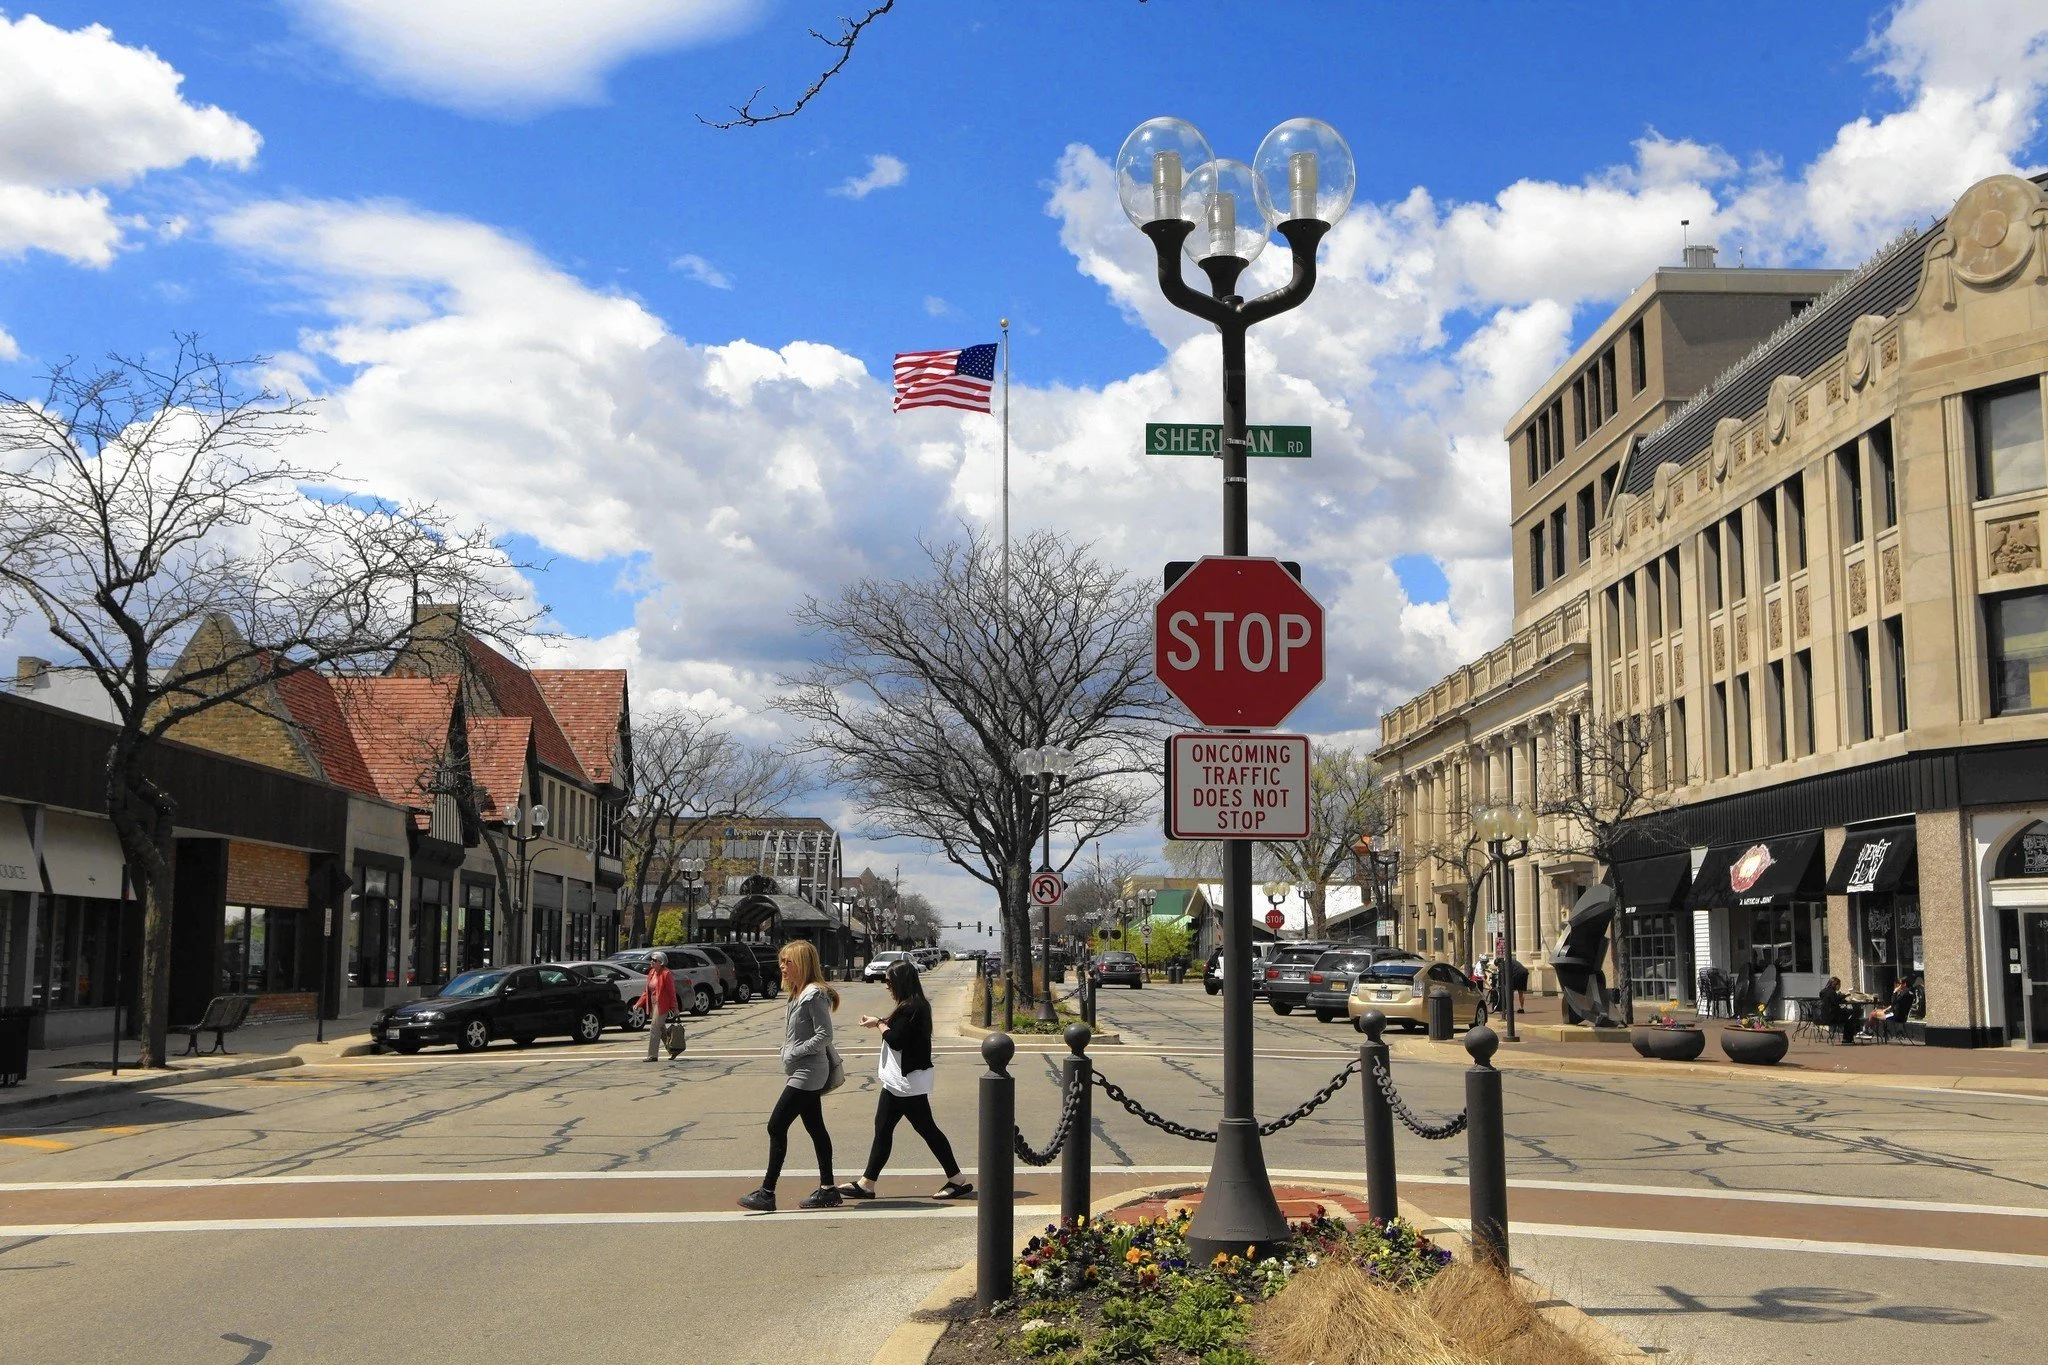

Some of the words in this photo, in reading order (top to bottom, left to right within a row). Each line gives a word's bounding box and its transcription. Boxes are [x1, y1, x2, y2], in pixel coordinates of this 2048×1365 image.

[1154, 428, 1274, 453] SHERIAN
[1287, 441, 1304, 453] RD
[1166, 610, 1313, 673] STOP
[1192, 744, 1291, 764] ONCOMING
[1202, 766, 1281, 786] TRAFFIC
[1193, 788, 1243, 808] DOES
[1253, 789, 1289, 808] NOT
[1217, 810, 1267, 830] STOP
[1266, 915, 1284, 924] STOP
